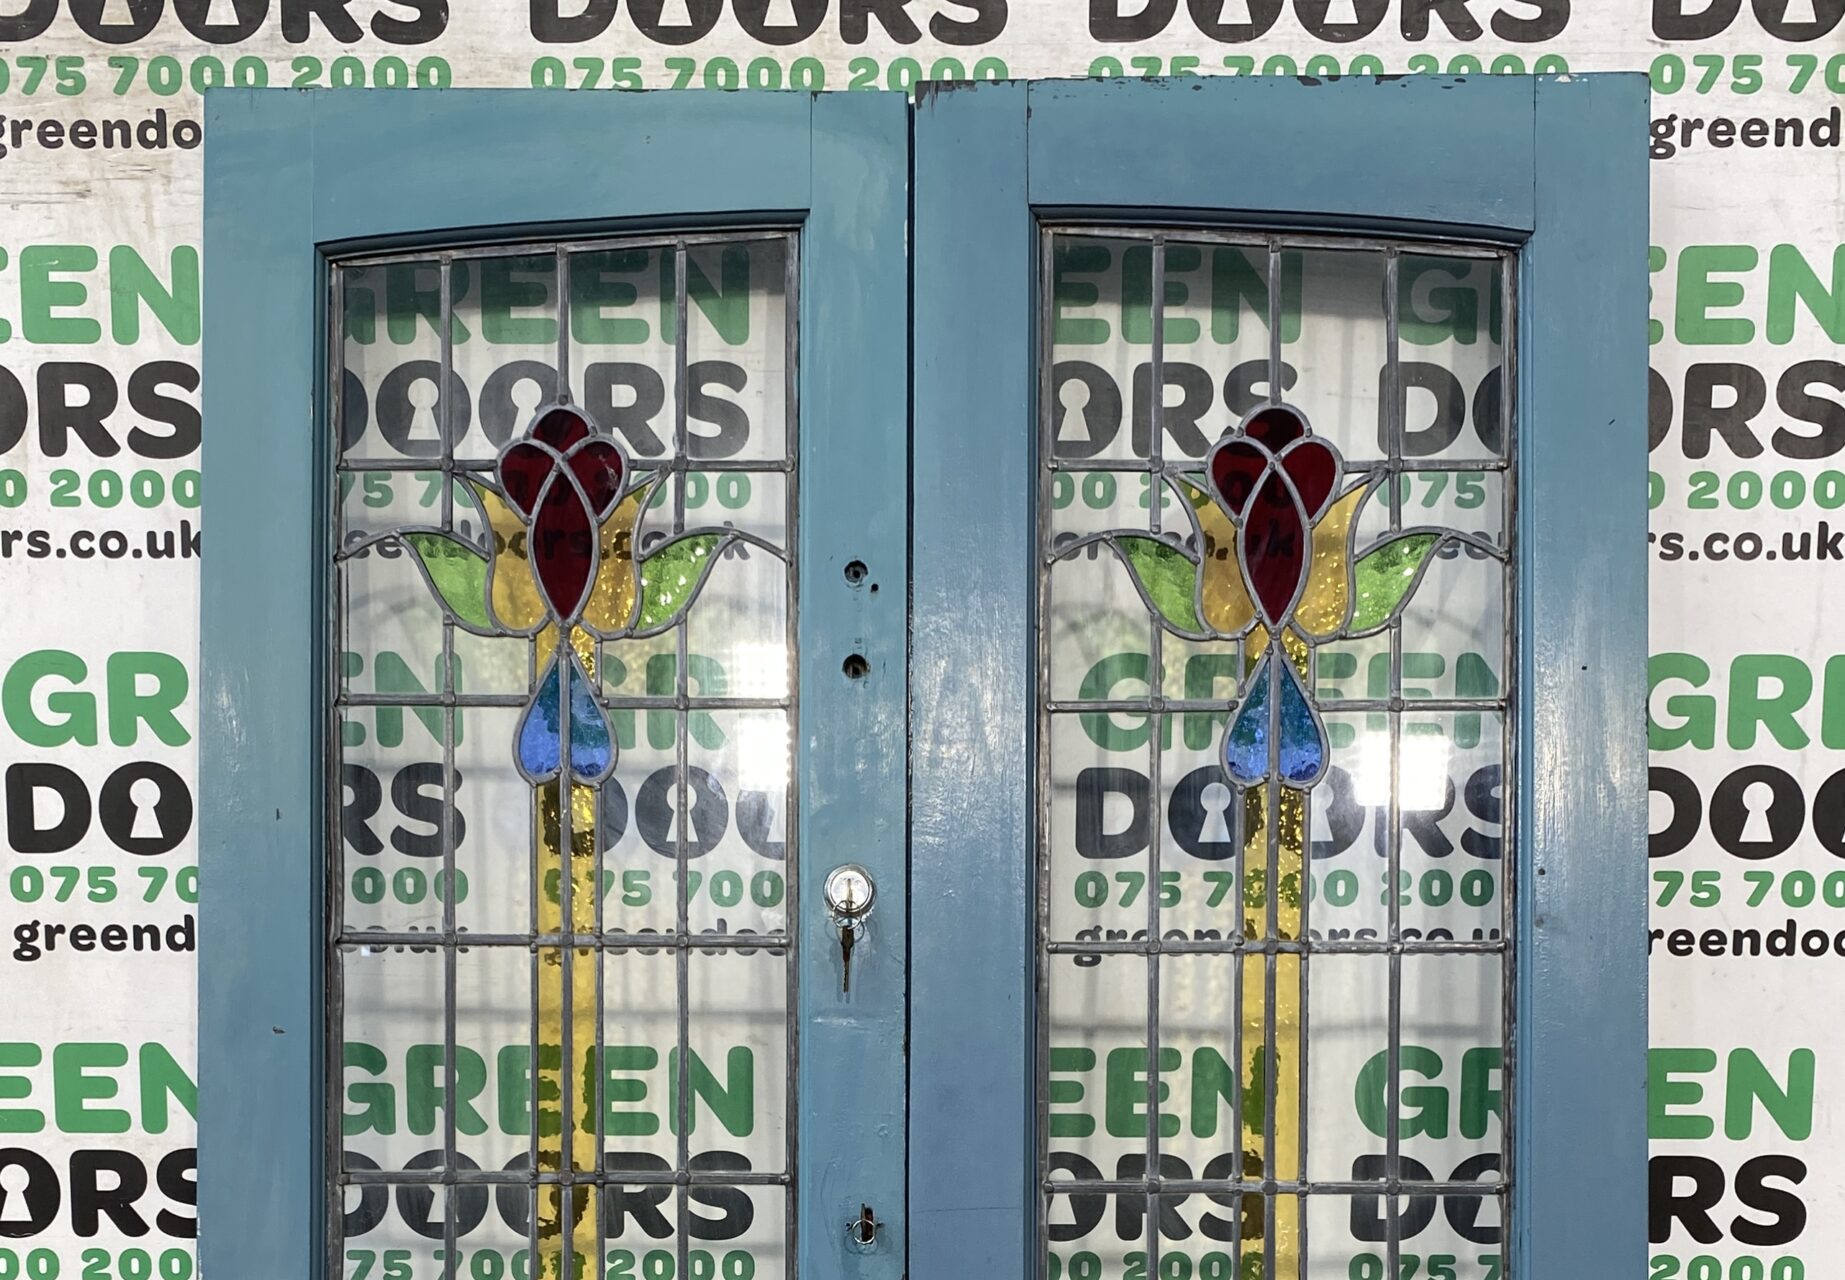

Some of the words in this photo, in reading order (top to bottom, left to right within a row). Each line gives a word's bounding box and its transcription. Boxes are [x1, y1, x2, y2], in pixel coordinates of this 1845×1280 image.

[0, 56, 87, 96] 75
[107, 55, 268, 96] 7000
[1650, 54, 1764, 95] 075
[0, 108, 203, 160] reendo
[1649, 106, 1841, 160] greend
[0, 244, 202, 346] EN
[1382, 256, 1501, 346] G
[1648, 243, 1845, 345] EN
[0, 360, 202, 459] RS
[344, 359, 751, 459] OORS
[1378, 361, 1501, 458] D
[1648, 359, 1845, 460] RS
[49, 469, 202, 509] 2000
[1687, 470, 1845, 510] 2000
[2, 649, 192, 748] GR
[343, 651, 464, 749] N
[5, 761, 194, 856] DO
[9, 865, 118, 903] 075
[1074, 870, 1181, 909] 075
[1653, 870, 1721, 908] 75
[13, 914, 196, 962] greend
[1648, 1047, 1816, 1141] EN
[1648, 1154, 1808, 1246] RS
